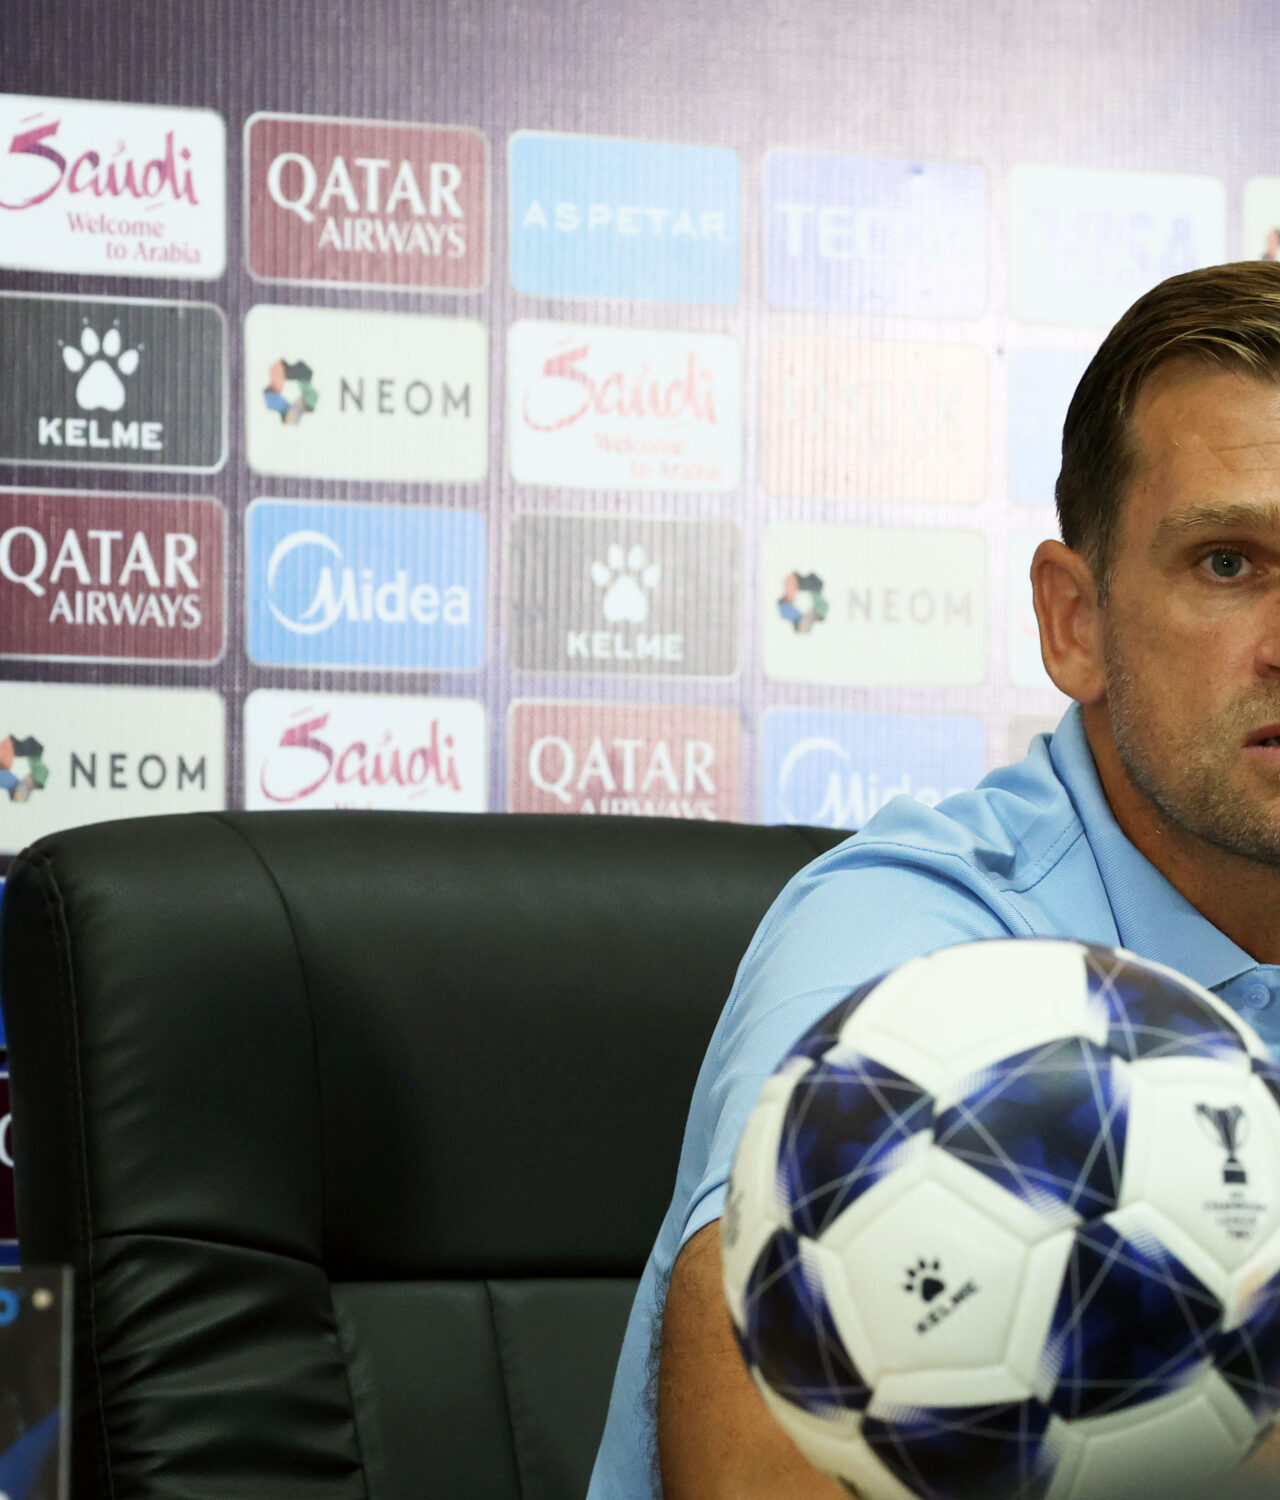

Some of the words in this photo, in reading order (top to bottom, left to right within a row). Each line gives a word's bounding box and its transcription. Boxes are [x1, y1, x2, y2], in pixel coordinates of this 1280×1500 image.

[267, 152, 464, 223] QATAR
[66, 211, 164, 238] Welcome
[318, 217, 466, 258] AIRWAYS
[522, 200, 727, 244] ASPETAR
[106, 240, 129, 261] to
[133, 241, 202, 265] Arabia
[340, 376, 471, 419] NEOM
[39, 417, 163, 450] KELME
[0, 526, 199, 597] QATAR
[49, 591, 201, 629] AIRWAYS
[847, 589, 973, 625] NEOM
[568, 631, 685, 662] KELME
[70, 752, 206, 790] NEOM
[528, 735, 716, 804] QATAR
